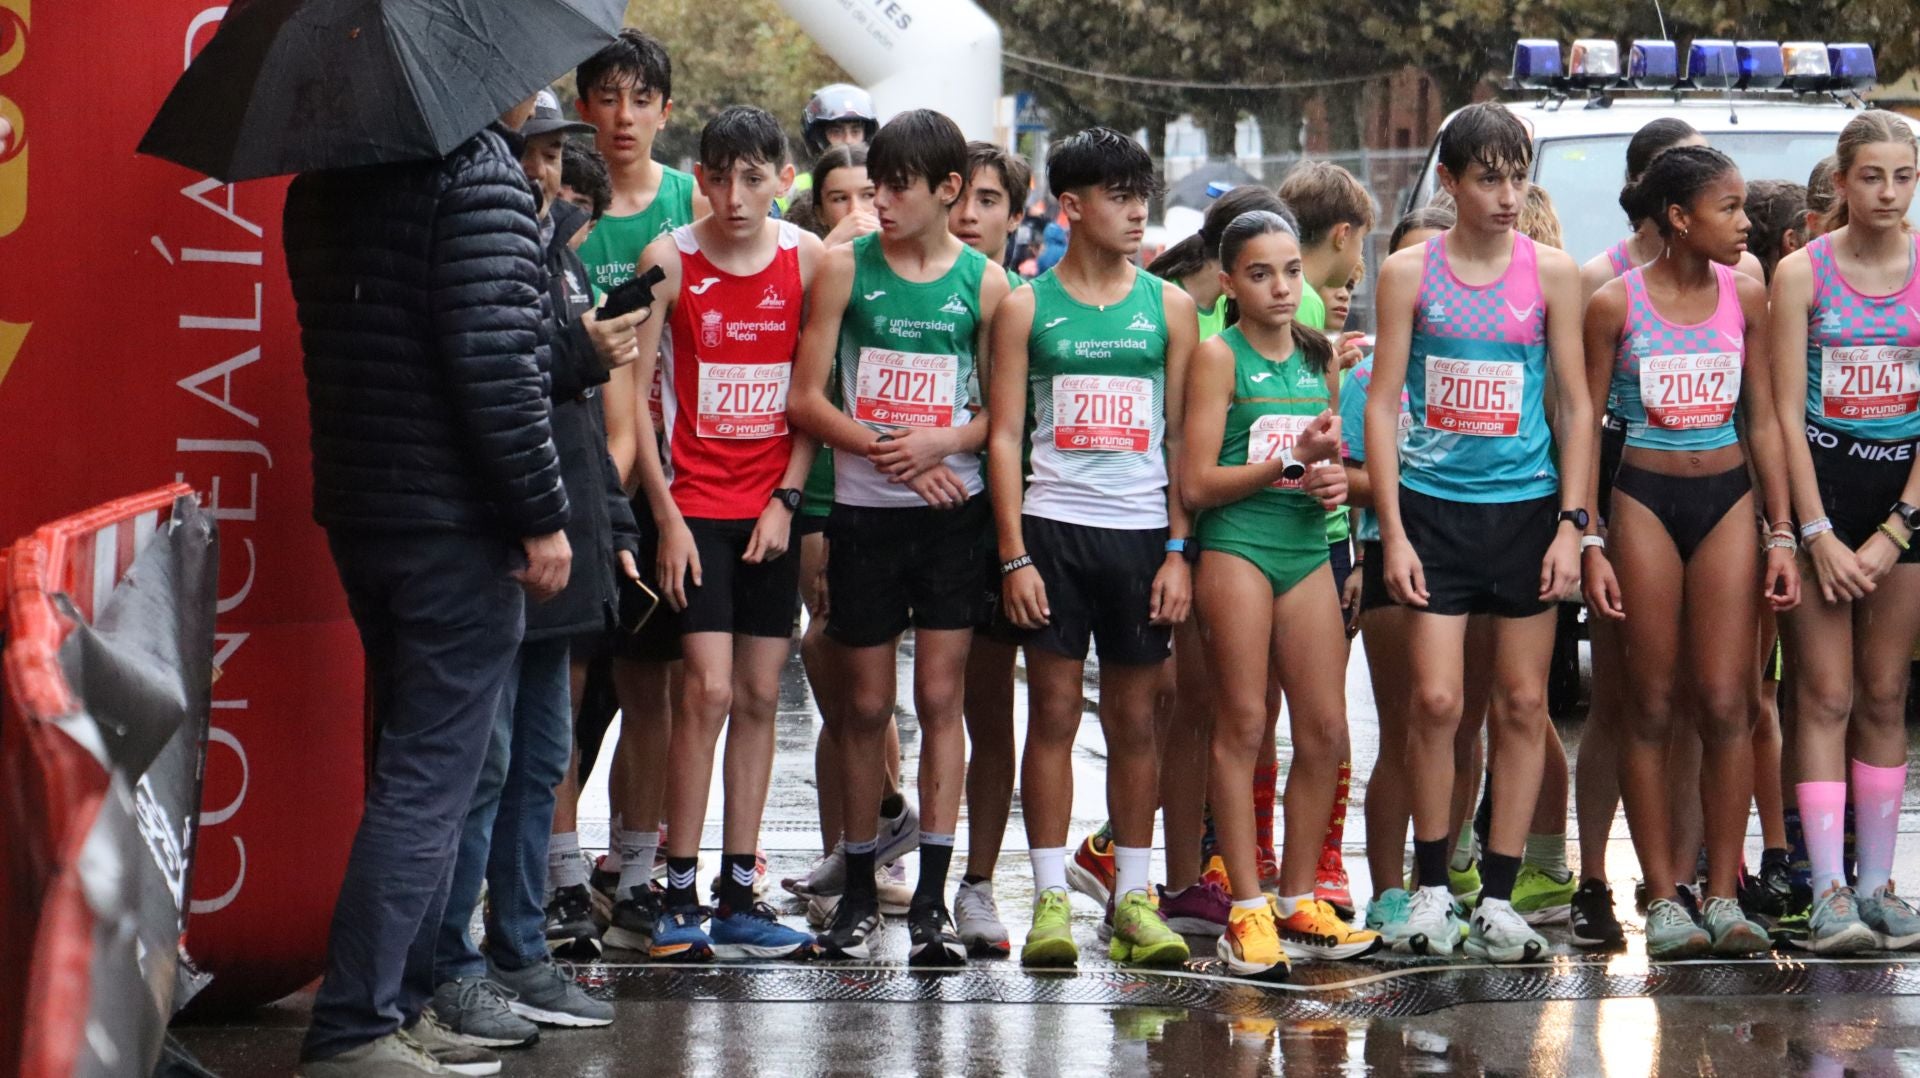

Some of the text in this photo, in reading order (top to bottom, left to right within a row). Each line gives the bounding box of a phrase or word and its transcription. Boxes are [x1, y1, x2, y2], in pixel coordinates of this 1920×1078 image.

[726, 320, 786, 332] universidad
[889, 318, 955, 333] universidad
[734, 330, 757, 341] león
[898, 326, 921, 339] león
[1075, 338, 1147, 350] universidad
[1084, 347, 1111, 359] león
[1840, 362, 1904, 395] 2047
[877, 368, 936, 403] 2021
[1659, 371, 1725, 405] 2042
[716, 382, 779, 414] 2022
[1440, 376, 1507, 411] 2005
[1074, 393, 1133, 426] 2018
[1861, 403, 1907, 415] HYUNDAI
[891, 412, 938, 424] HYUNDAI
[1682, 414, 1724, 425] HYUNDAI
[736, 423, 775, 434] HYUNDAI
[1458, 420, 1504, 431] HYUNDAI
[1090, 435, 1134, 446] HYUNDAI
[1806, 424, 1838, 449] RO
[1848, 442, 1912, 462] NIKE
